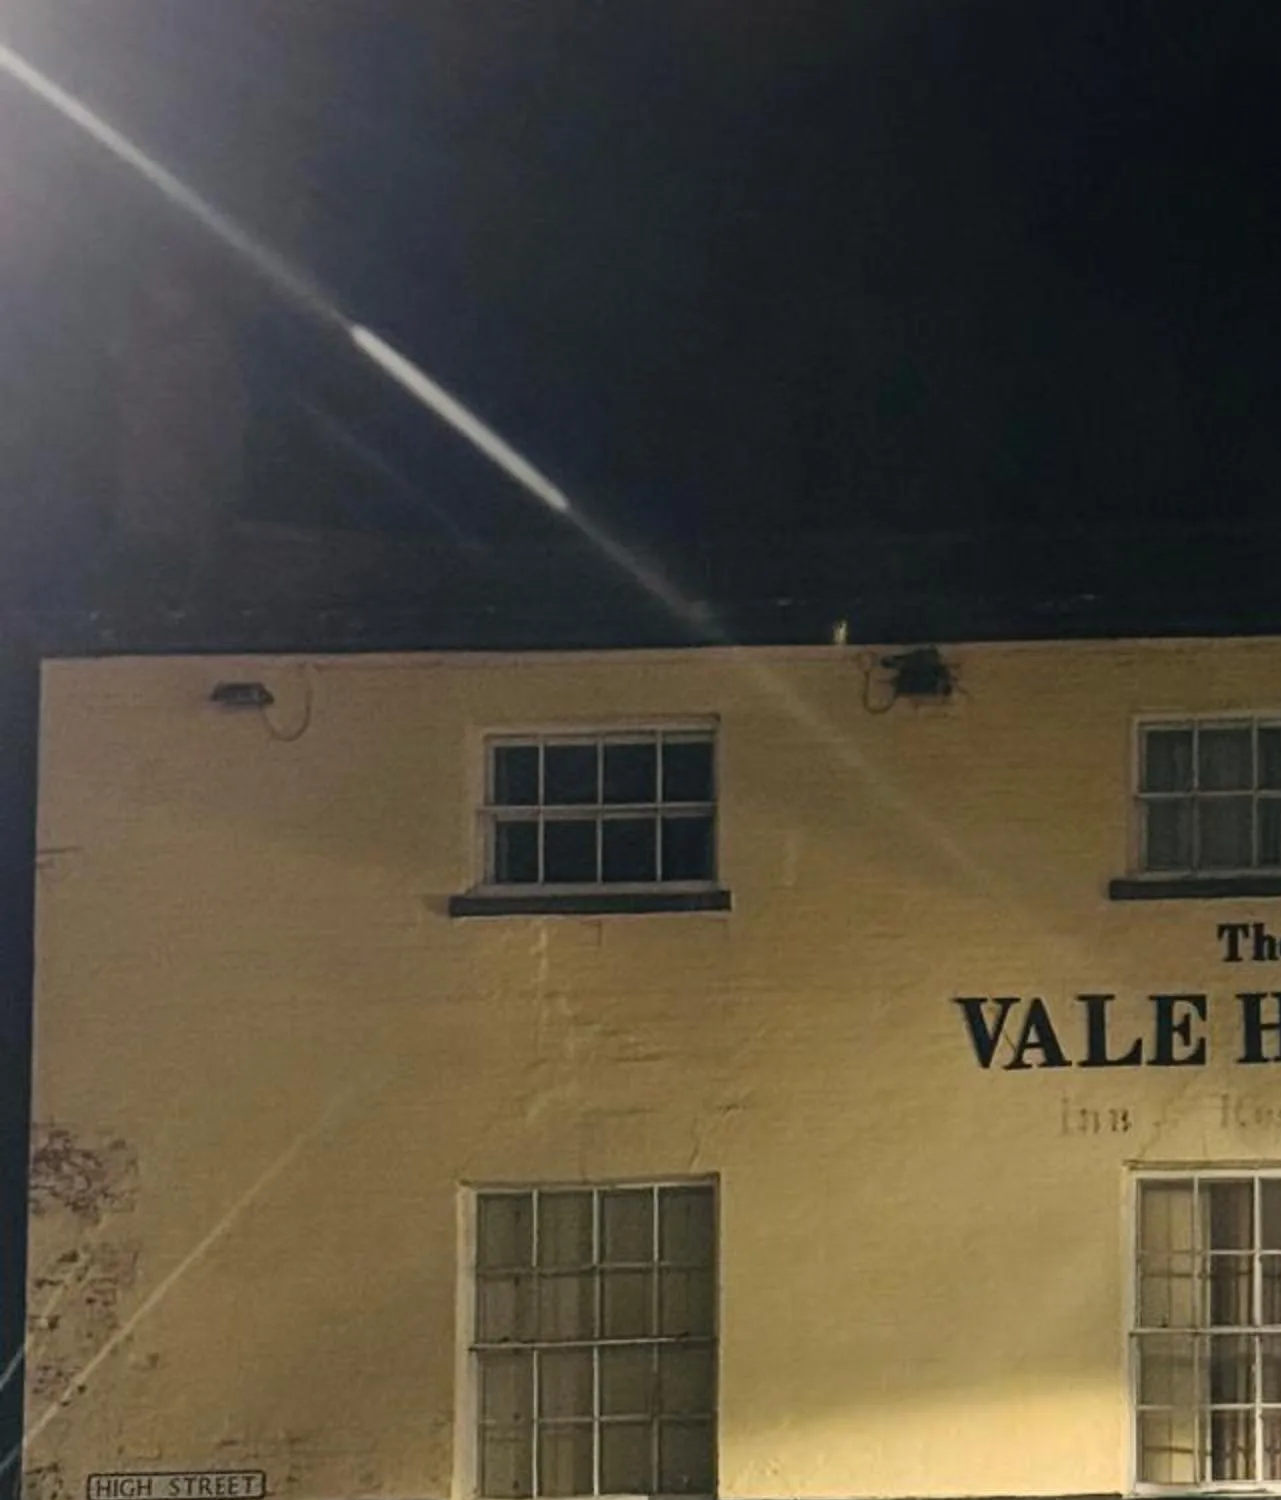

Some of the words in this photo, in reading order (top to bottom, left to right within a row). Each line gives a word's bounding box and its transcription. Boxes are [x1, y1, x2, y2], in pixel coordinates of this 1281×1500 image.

[951, 994, 1207, 1070] VALE
[96, 1478, 153, 1497] HIGH
[168, 1475, 257, 1496] STREET
